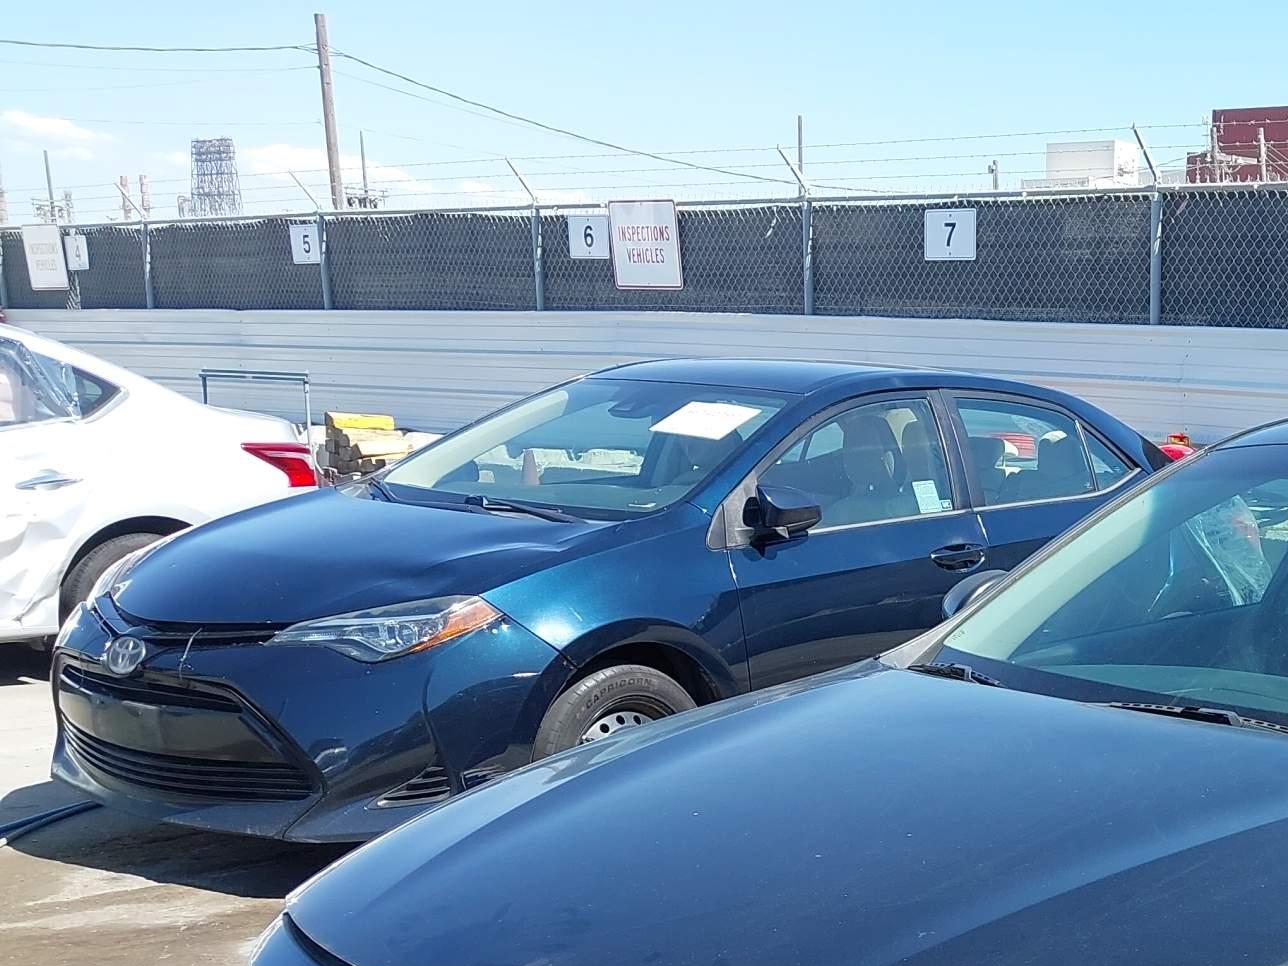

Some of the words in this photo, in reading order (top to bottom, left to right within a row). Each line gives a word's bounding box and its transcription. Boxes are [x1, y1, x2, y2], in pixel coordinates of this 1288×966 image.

[583, 225, 594, 248] 6
[617, 225, 670, 241] INSPECTIONS
[944, 222, 957, 247] 7
[75, 244, 82, 262] 4
[302, 234, 311, 254] 5
[626, 247, 665, 263] VEHICLES
[586, 678, 652, 708] CAPRICORN
